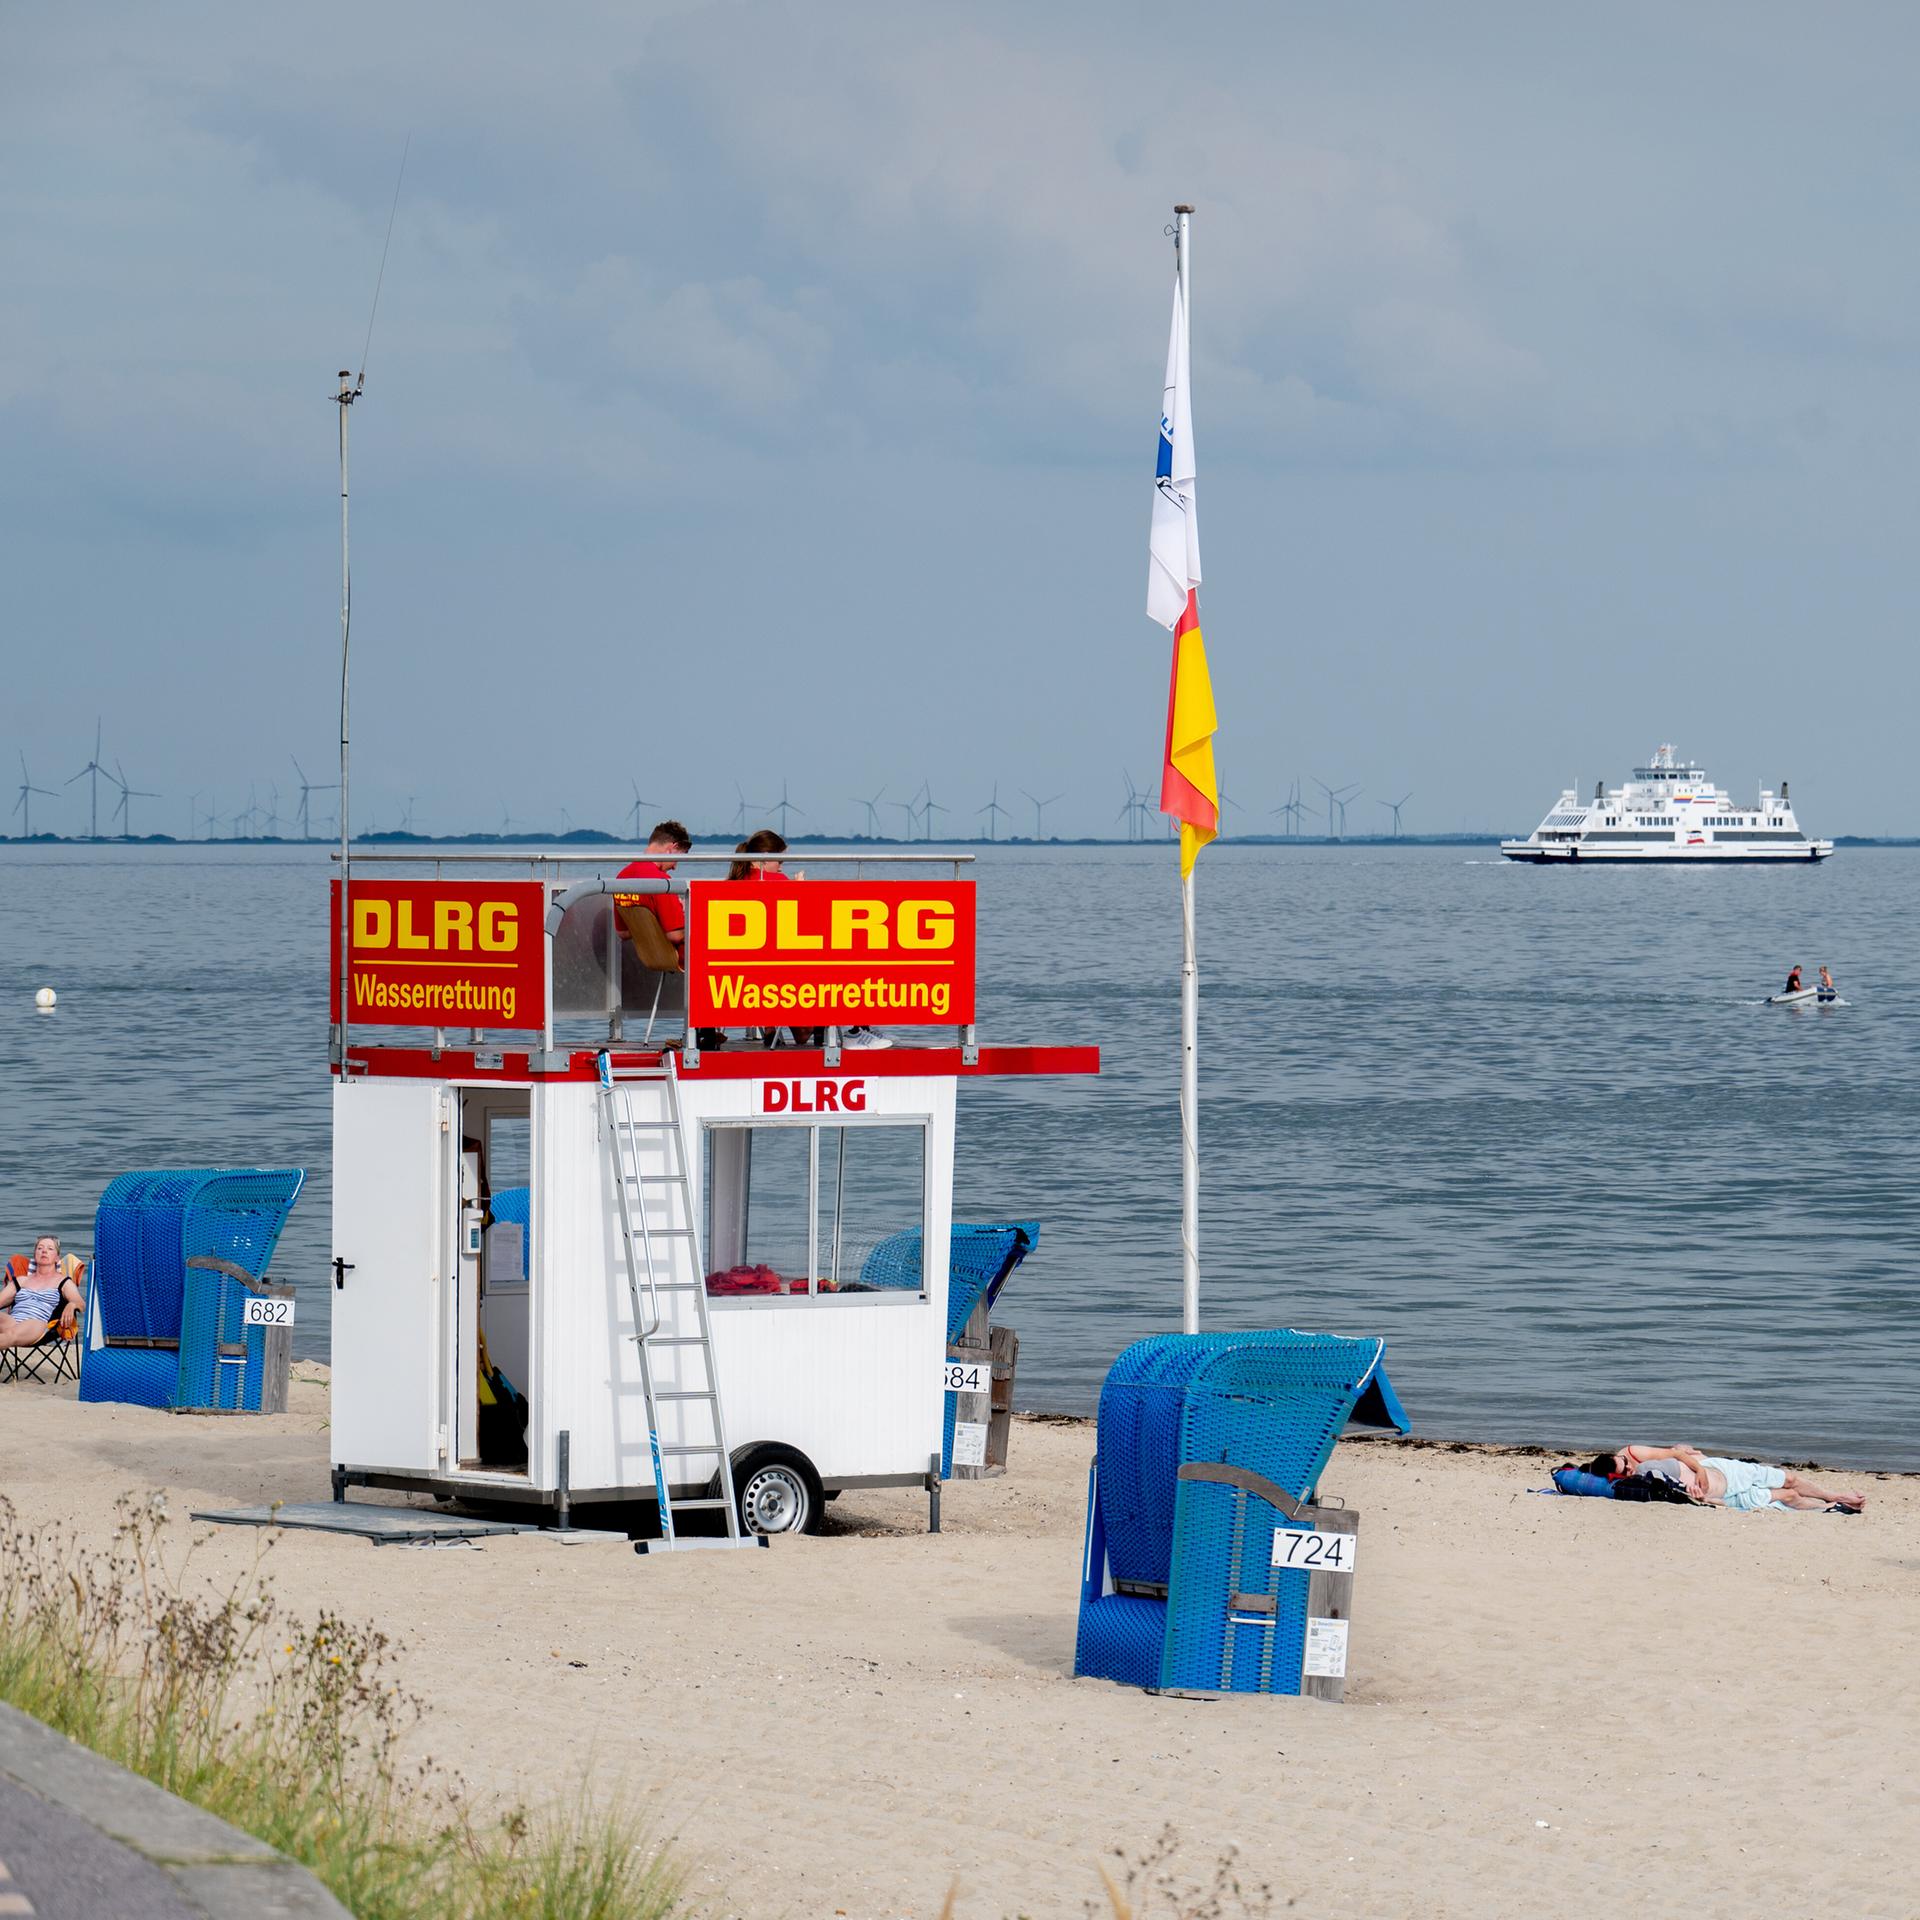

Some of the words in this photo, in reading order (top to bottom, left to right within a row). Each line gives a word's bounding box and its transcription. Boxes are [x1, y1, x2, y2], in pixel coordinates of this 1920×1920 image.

[353, 899, 519, 952] DLRG
[707, 899, 955, 950] DLRG
[353, 973, 516, 1020] Wasserrettung
[708, 975, 951, 1016] Wasserrettung
[763, 1079, 866, 1113] DLRG
[250, 1301, 288, 1323] 682
[1285, 1532, 1343, 1567] 724
